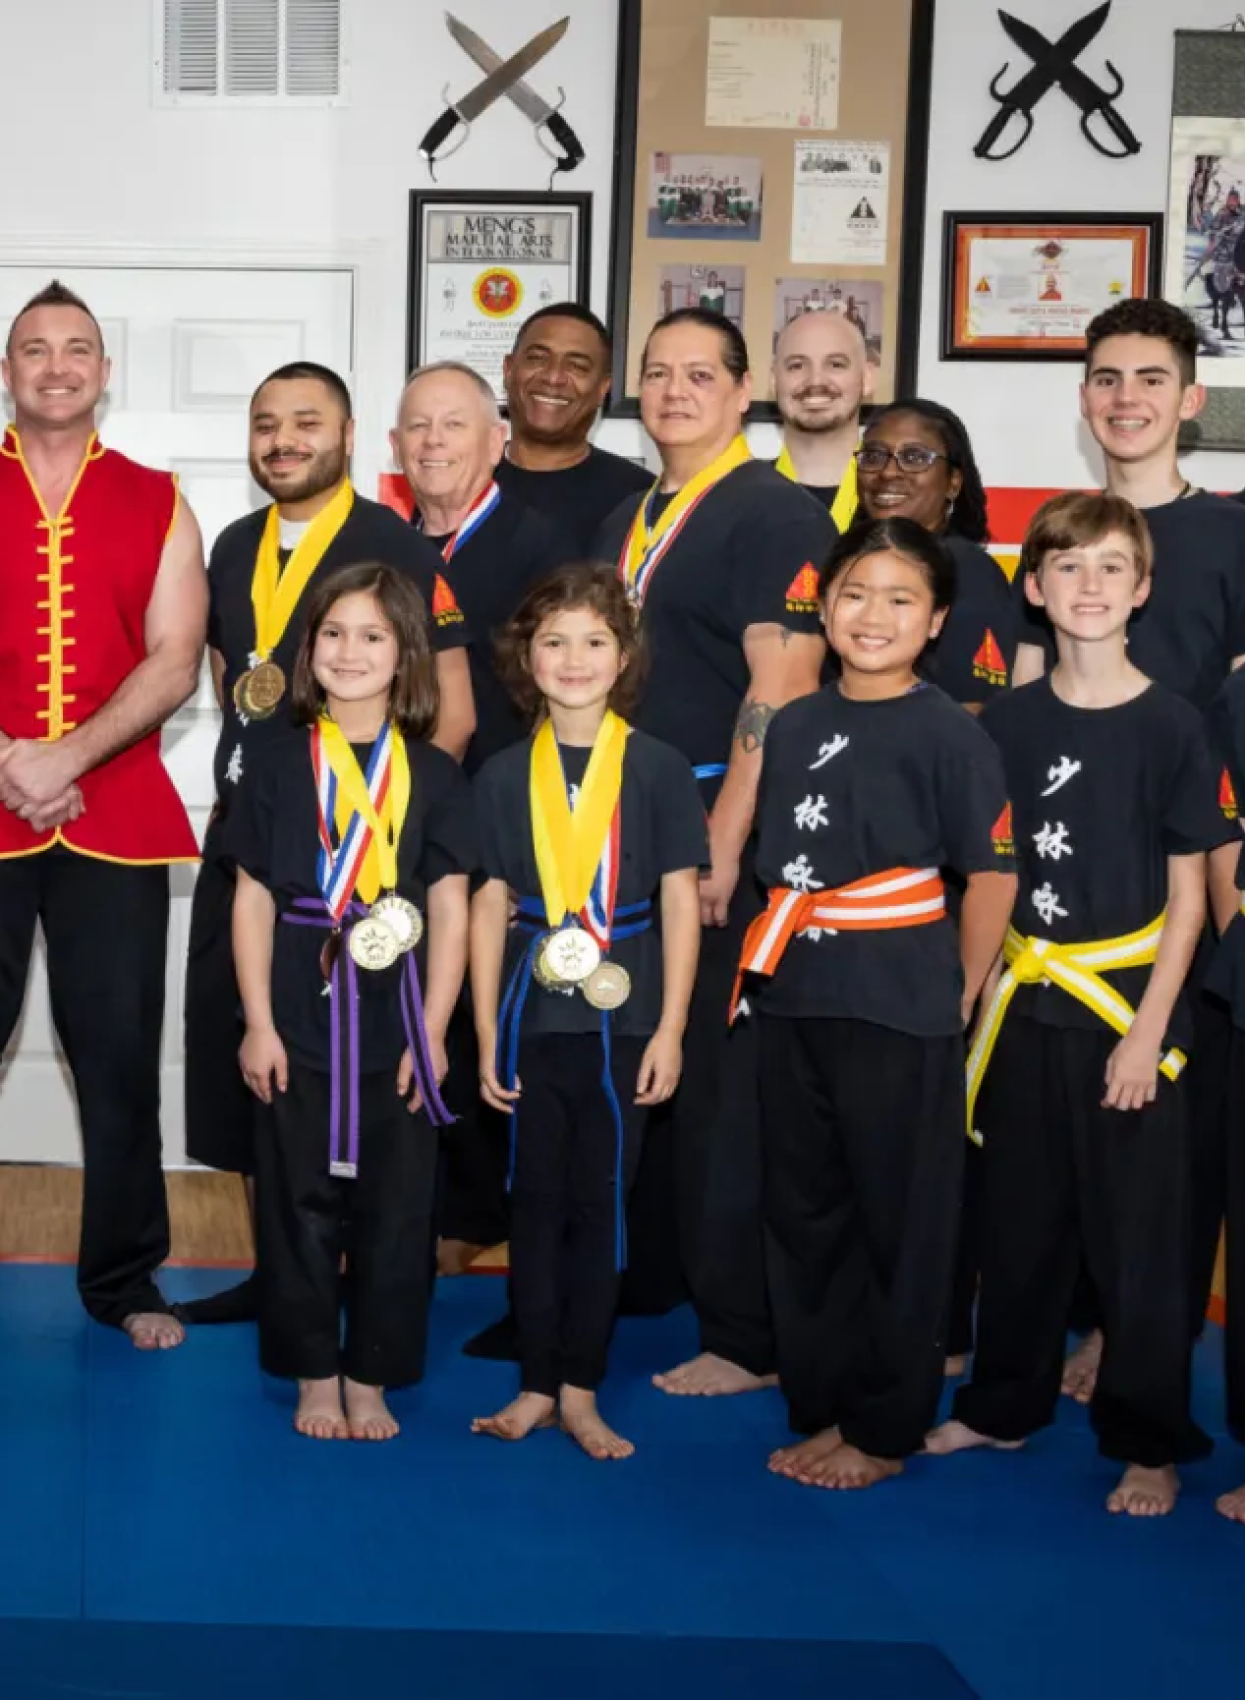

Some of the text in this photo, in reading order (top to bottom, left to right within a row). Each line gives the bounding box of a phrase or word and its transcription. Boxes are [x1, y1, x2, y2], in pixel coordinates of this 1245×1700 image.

[445, 233, 554, 247] MARTIAL ARTS
[445, 247, 553, 259] INTERNATIONAL
